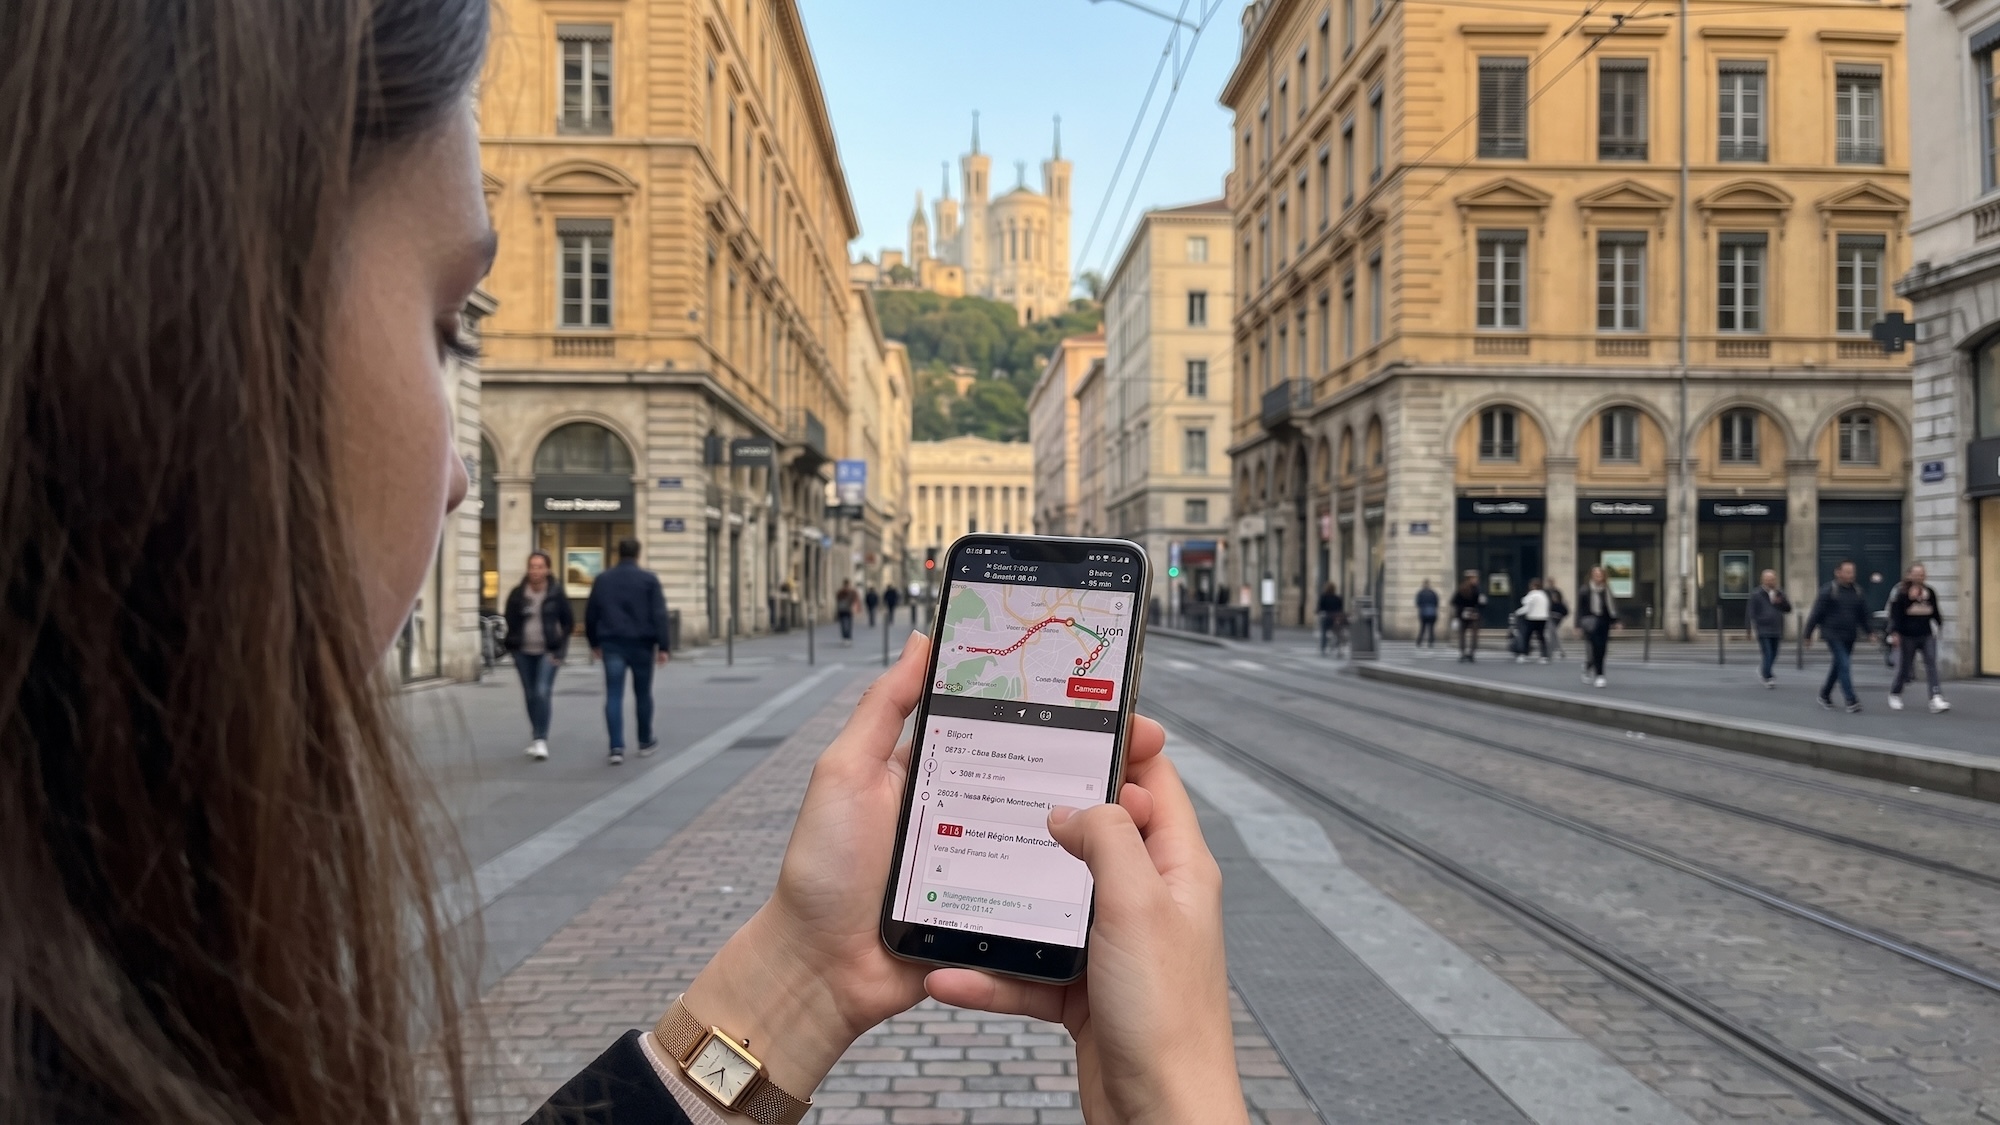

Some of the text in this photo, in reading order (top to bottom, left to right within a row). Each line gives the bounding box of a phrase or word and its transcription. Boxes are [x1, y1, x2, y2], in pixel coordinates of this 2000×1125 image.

[1095, 624, 1124, 639] Lyon
[1027, 755, 1044, 763] Lyon
[981, 794, 1005, 804] Région
[987, 831, 1014, 842] Région
